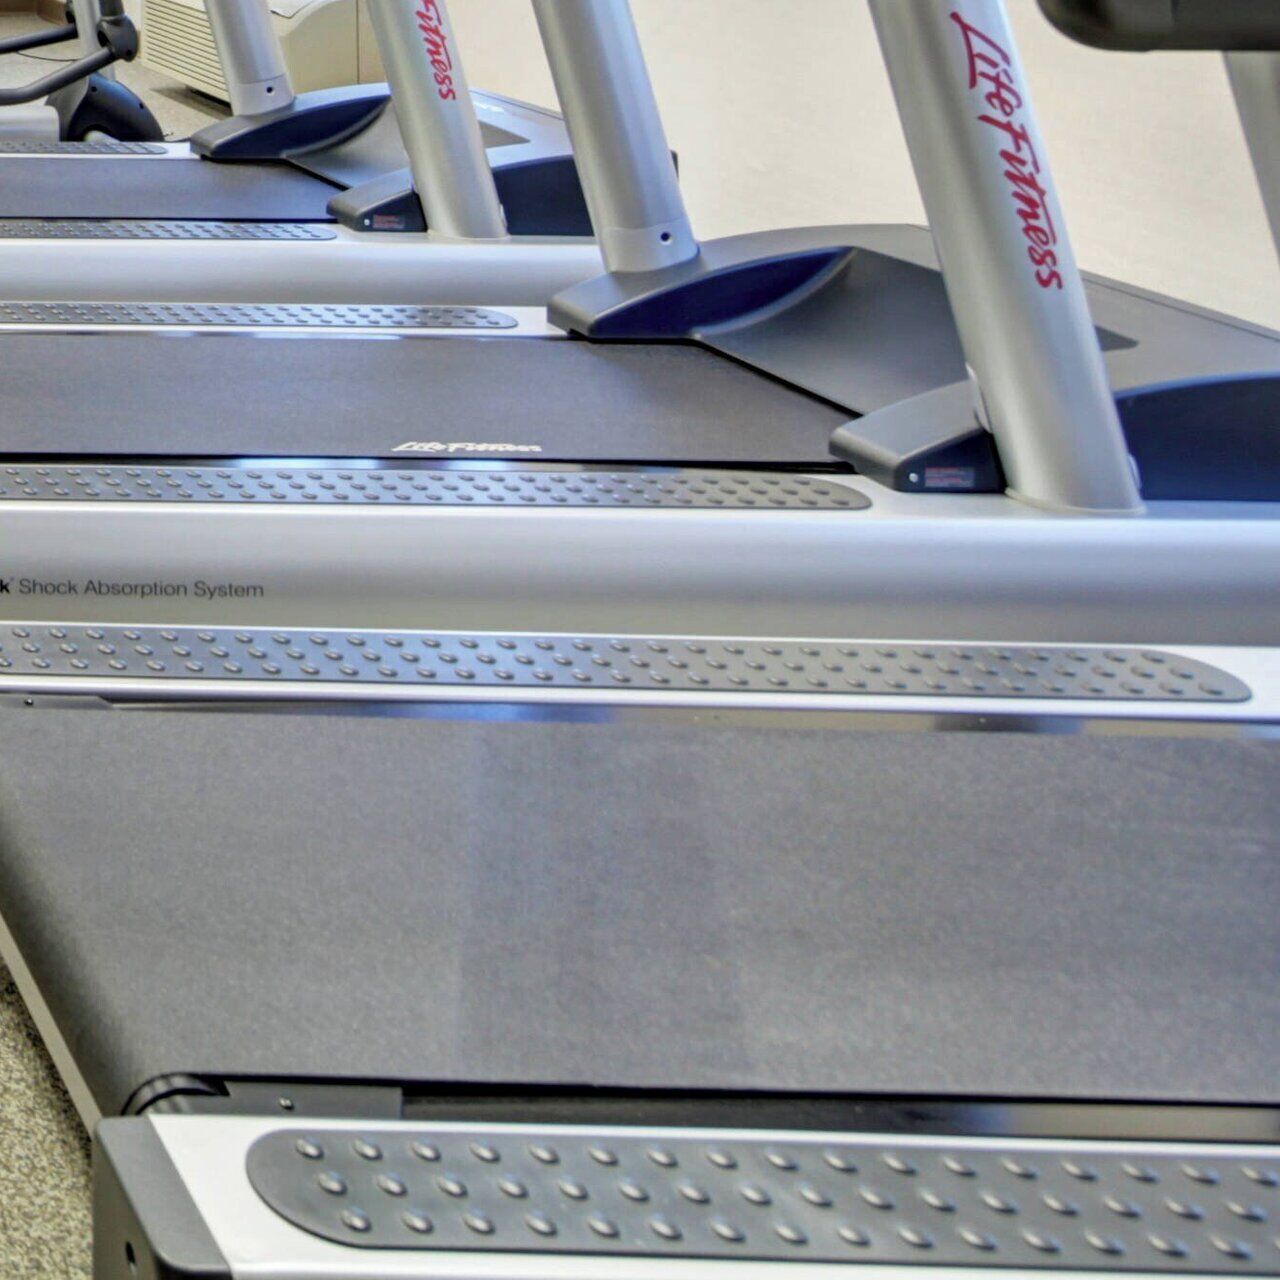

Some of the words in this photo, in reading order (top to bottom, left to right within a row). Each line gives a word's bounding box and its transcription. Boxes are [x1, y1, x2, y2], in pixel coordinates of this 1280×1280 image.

[19, 578, 79, 595] Shock
[84, 579, 187, 600] Absorption
[194, 581, 264, 599] System
